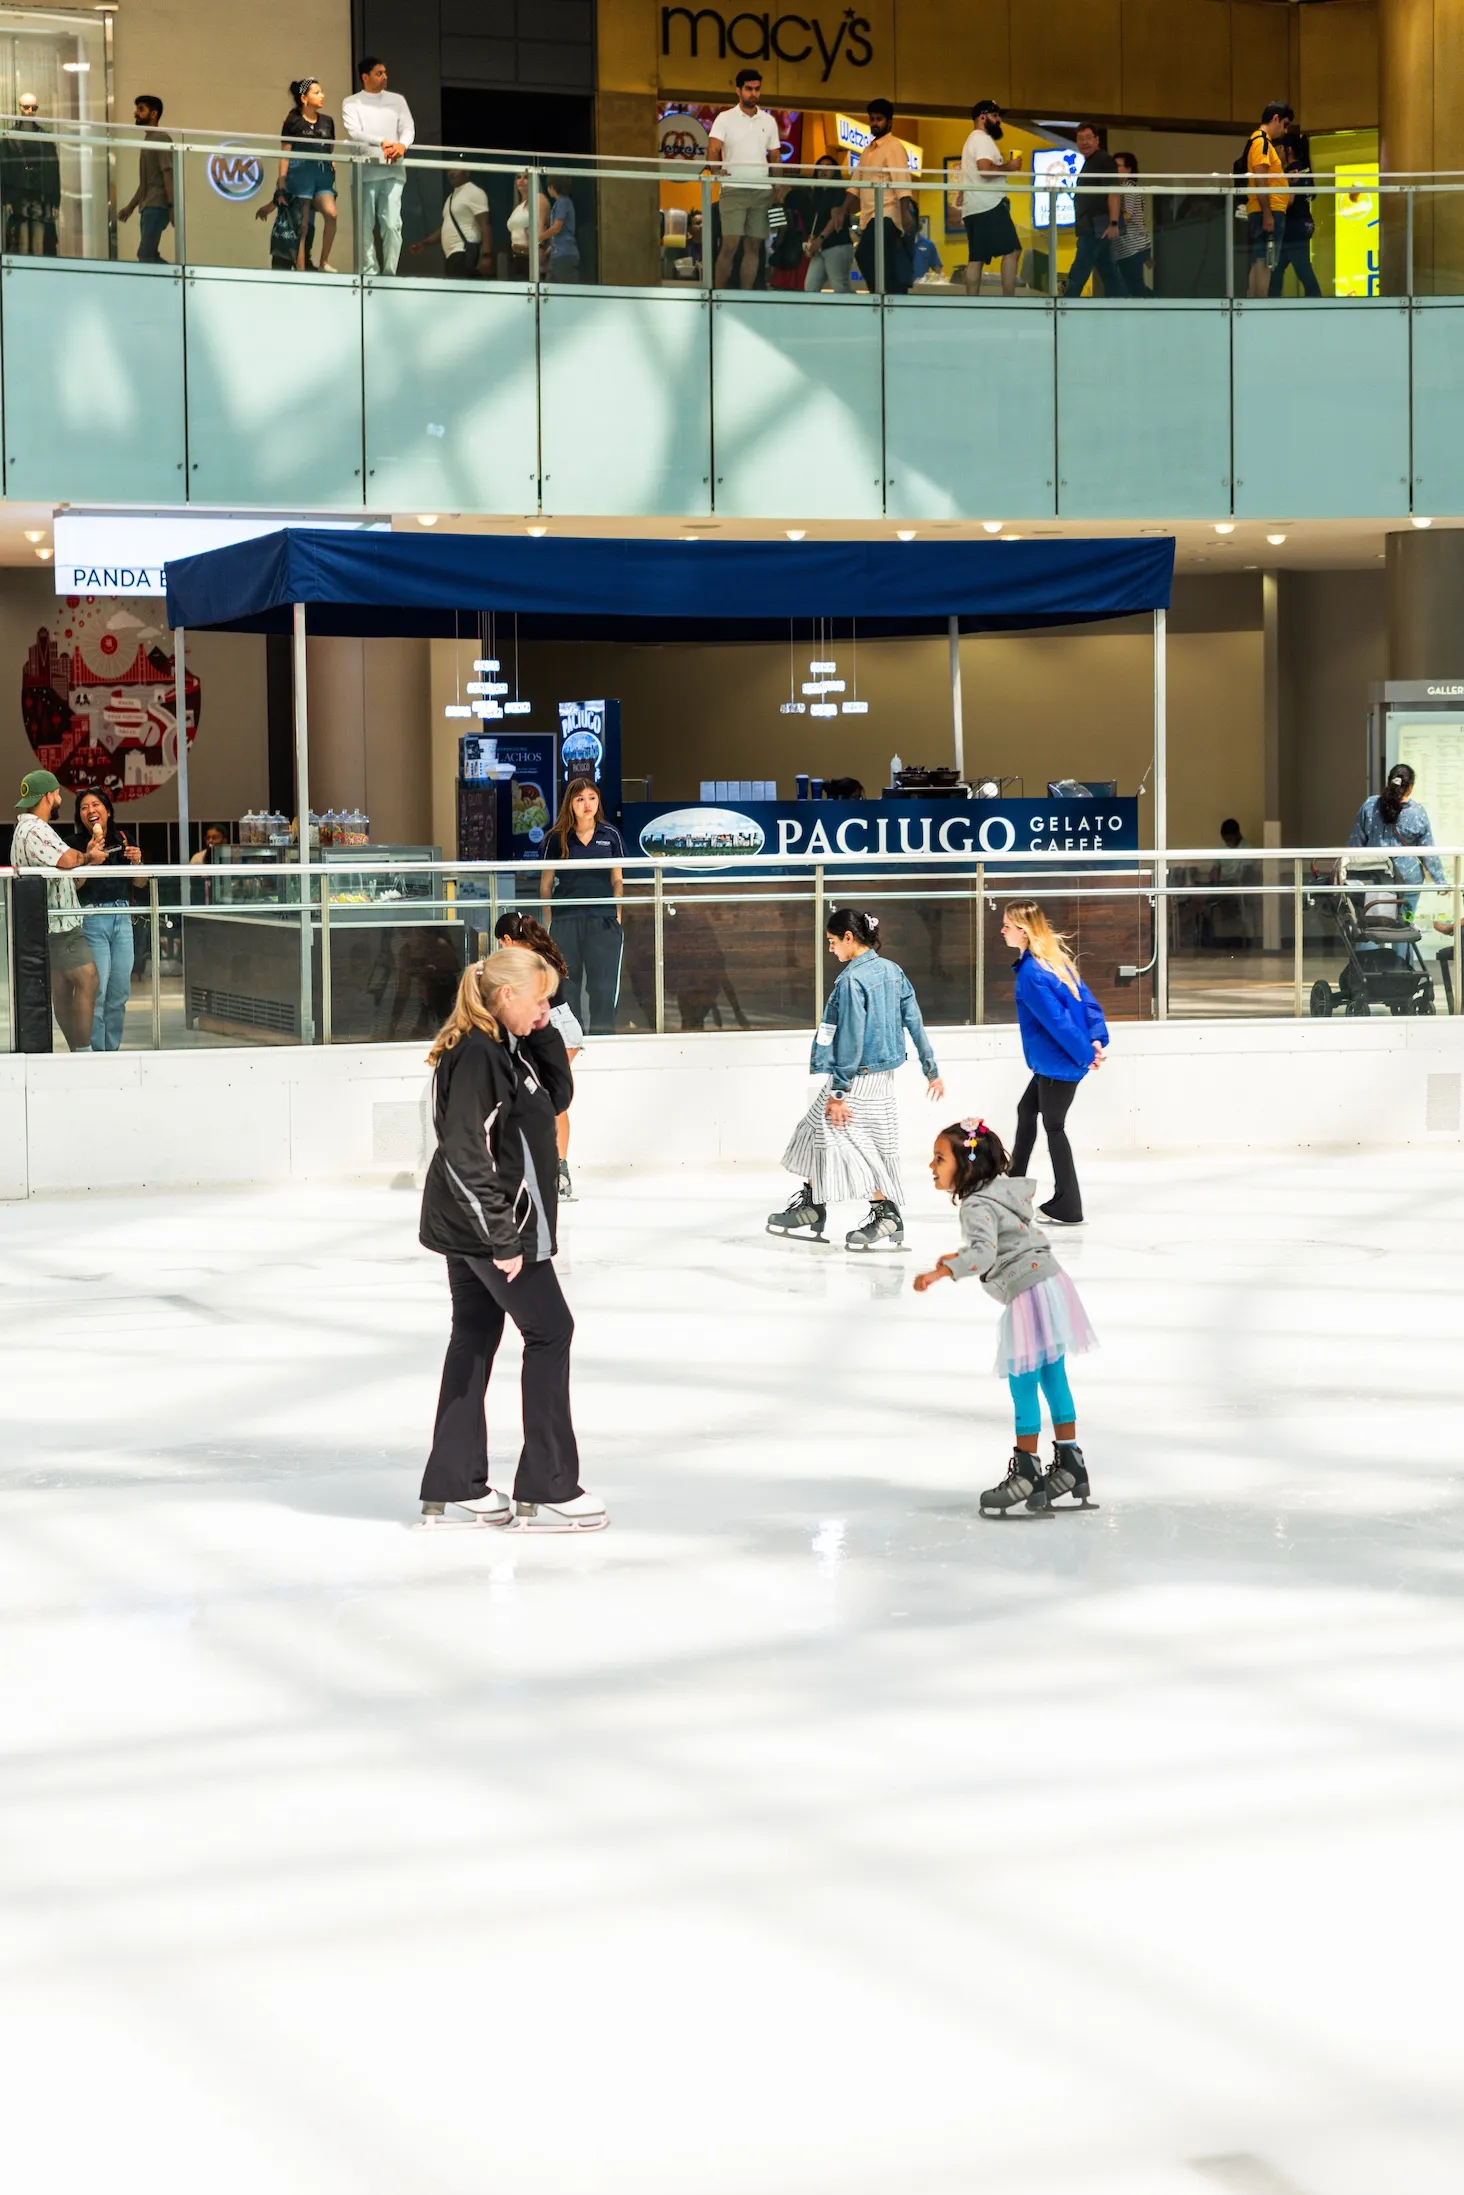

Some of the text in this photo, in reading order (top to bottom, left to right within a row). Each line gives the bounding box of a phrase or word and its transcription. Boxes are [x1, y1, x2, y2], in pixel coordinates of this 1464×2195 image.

[73, 569, 151, 588] PANDA
[561, 709, 602, 739] PACIUGO
[777, 816, 1123, 854] PACIUGO GELATO
[1029, 835, 1103, 851] CAFFÈ
